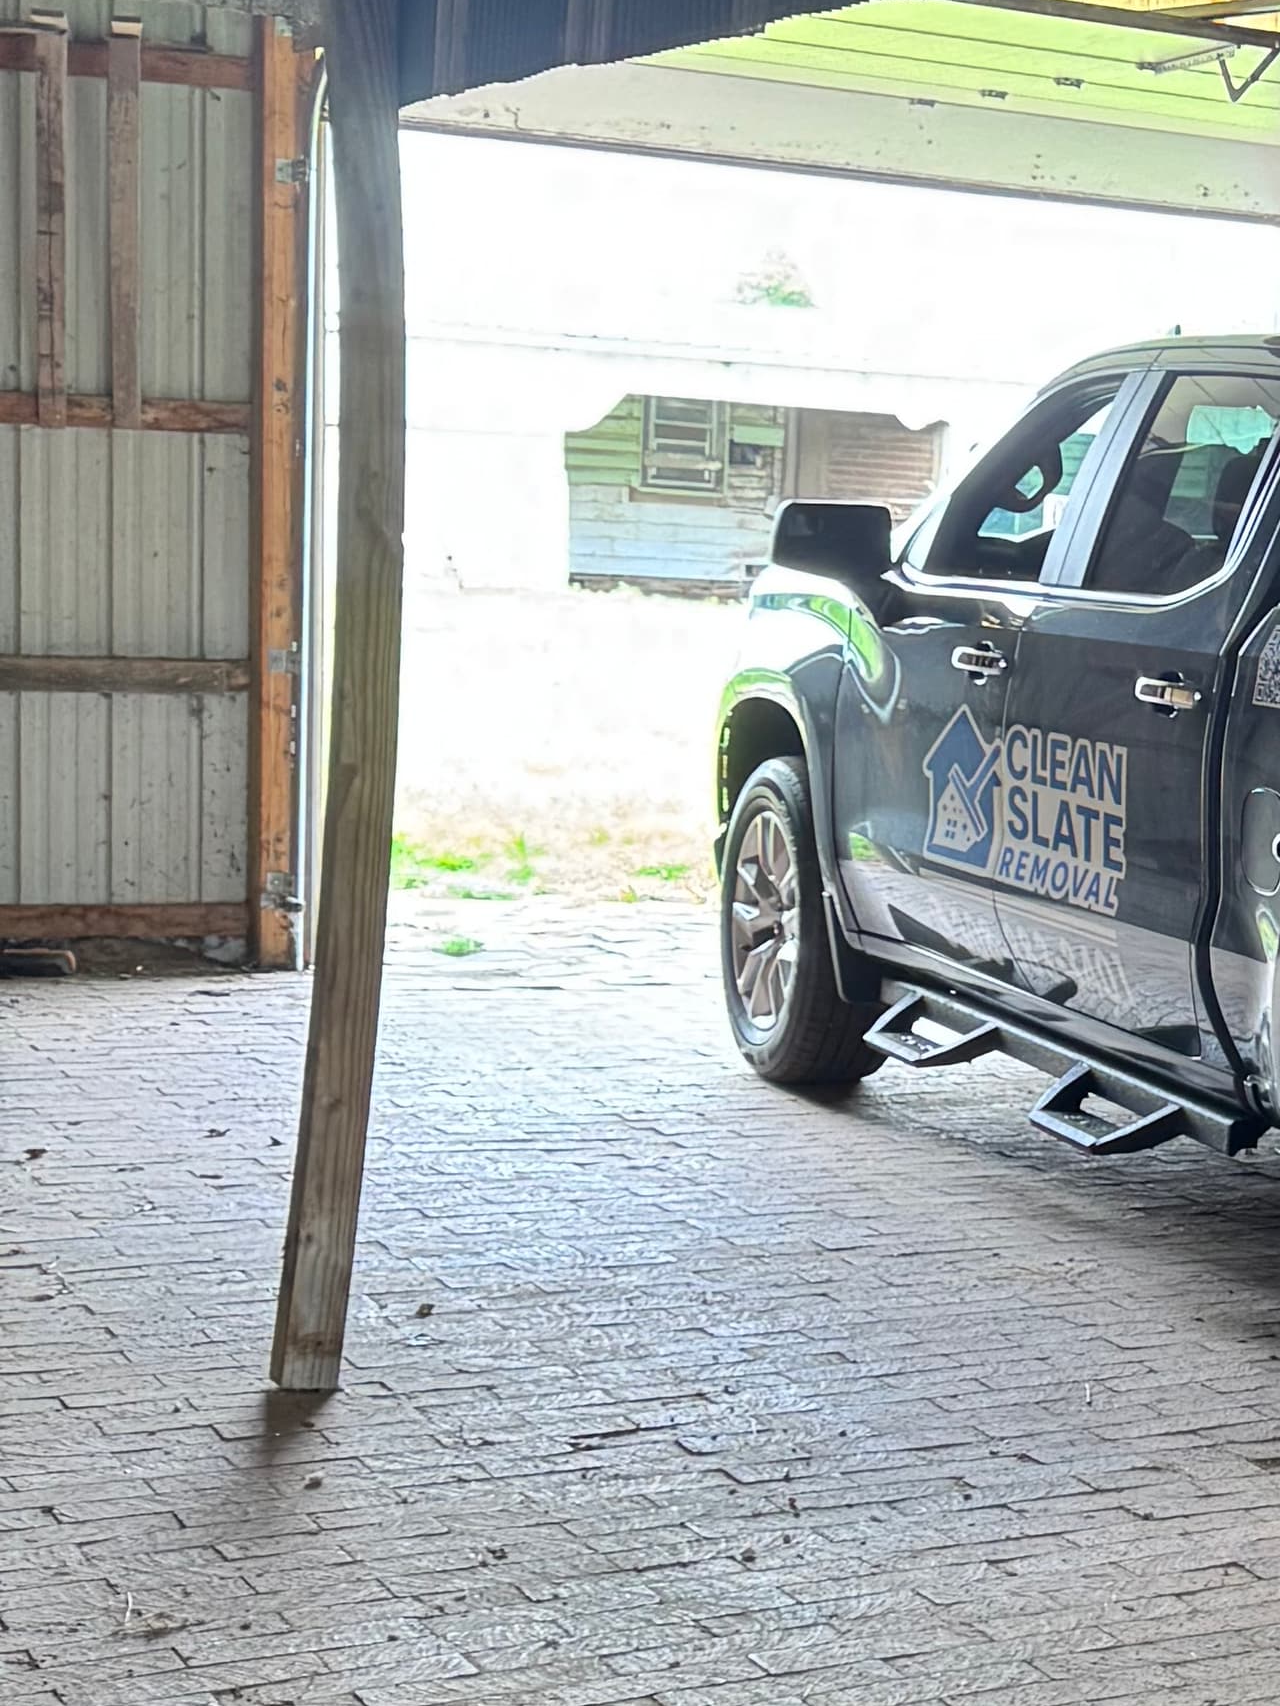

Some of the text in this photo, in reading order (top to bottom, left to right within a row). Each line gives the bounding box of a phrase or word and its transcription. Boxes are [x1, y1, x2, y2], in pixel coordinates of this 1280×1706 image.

[1005, 729, 1124, 806] CLEAN
[1006, 775, 1125, 874] SLATE
[999, 845, 1116, 910] REMOVAL
